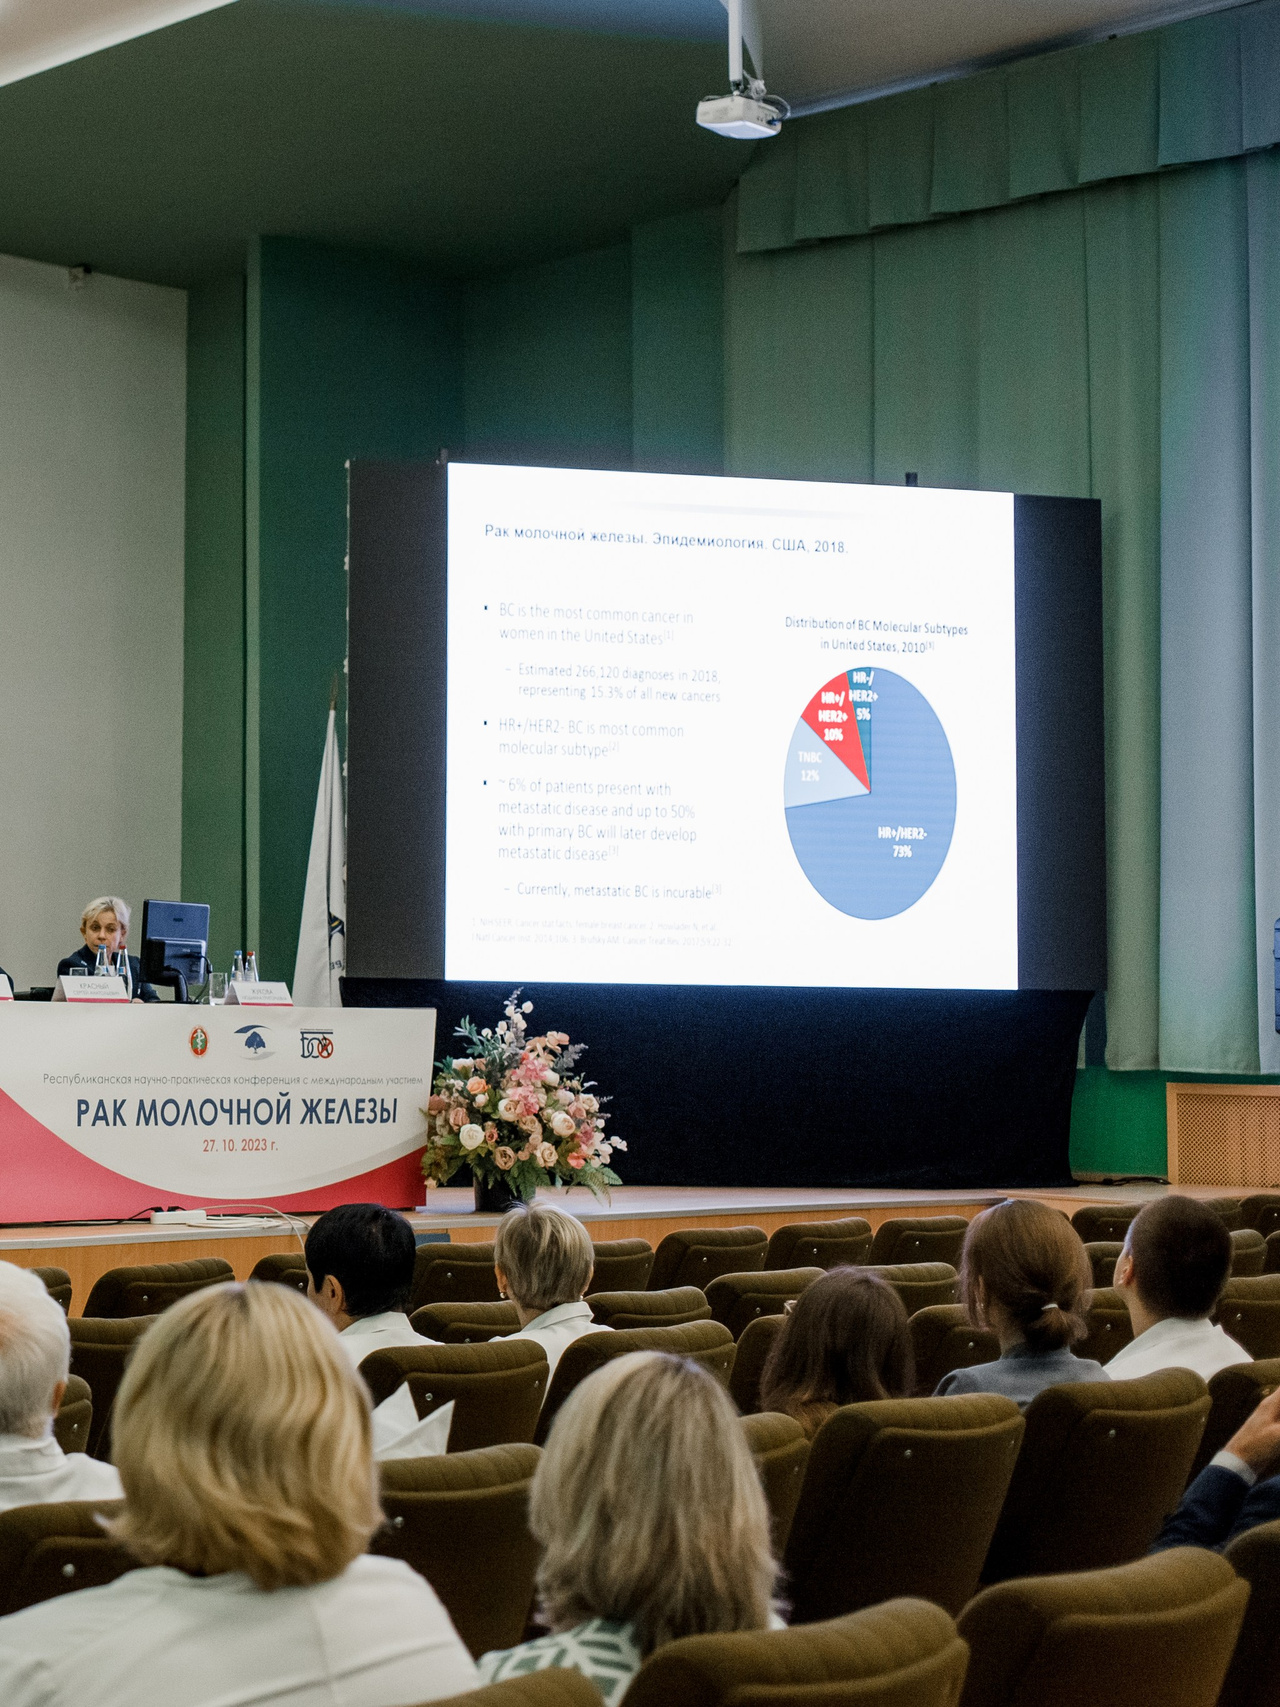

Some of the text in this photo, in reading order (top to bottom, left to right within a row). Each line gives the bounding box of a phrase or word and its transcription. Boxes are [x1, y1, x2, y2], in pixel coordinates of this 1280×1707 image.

[485, 524, 849, 554] Рак молочной железы. Эпидемиология. США, 2018.
[499, 602, 694, 624] BC is the most common cancer in
[785, 615, 968, 637] Distribution of BC Molecular Subtypes
[499, 629, 544, 640] women
[547, 628, 557, 641] in
[561, 627, 580, 641] the
[585, 628, 624, 643] United
[820, 637, 829, 648] in
[832, 638, 865, 650] United
[867, 640, 899, 653] States,
[518, 663, 720, 683] Estimated 266,120 diagnoses in 2018,
[518, 684, 720, 702] representing 15.3% of all new cancers
[821, 690, 845, 706] HR+/
[849, 689, 878, 702] HER2+
[818, 709, 848, 723] HER2+
[856, 707, 871, 720] 5%
[499, 717, 684, 738] HR+/HER2- BC is most common
[823, 728, 843, 741] 10%
[499, 740, 558, 755] molecular
[798, 750, 823, 764] TNBC
[801, 769, 820, 782] 12%
[530, 778, 542, 793] of
[545, 780, 594, 796] patients
[597, 782, 642, 798] present
[646, 782, 671, 796] with
[499, 801, 695, 820] metastatic disease and up to 50%
[499, 822, 697, 844] with primary BC will later develop
[878, 825, 927, 841] HR+/HER2-
[499, 845, 561, 860] metastatic
[892, 844, 912, 858] 73%
[517, 881, 570, 898] Currently,
[574, 883, 631, 897] metastatic
[635, 884, 648, 898] BC
[651, 885, 660, 898] is
[43, 1073, 423, 1087] Республиканская научно-практическая конференция с международным участием
[77, 1092, 398, 1127] РАК МОЛОЧНОЙ ЖЕЛЕЗЫ
[202, 1140, 218, 1153] 27.
[222, 1139, 238, 1152] 10.
[241, 1139, 267, 1152] 2023
